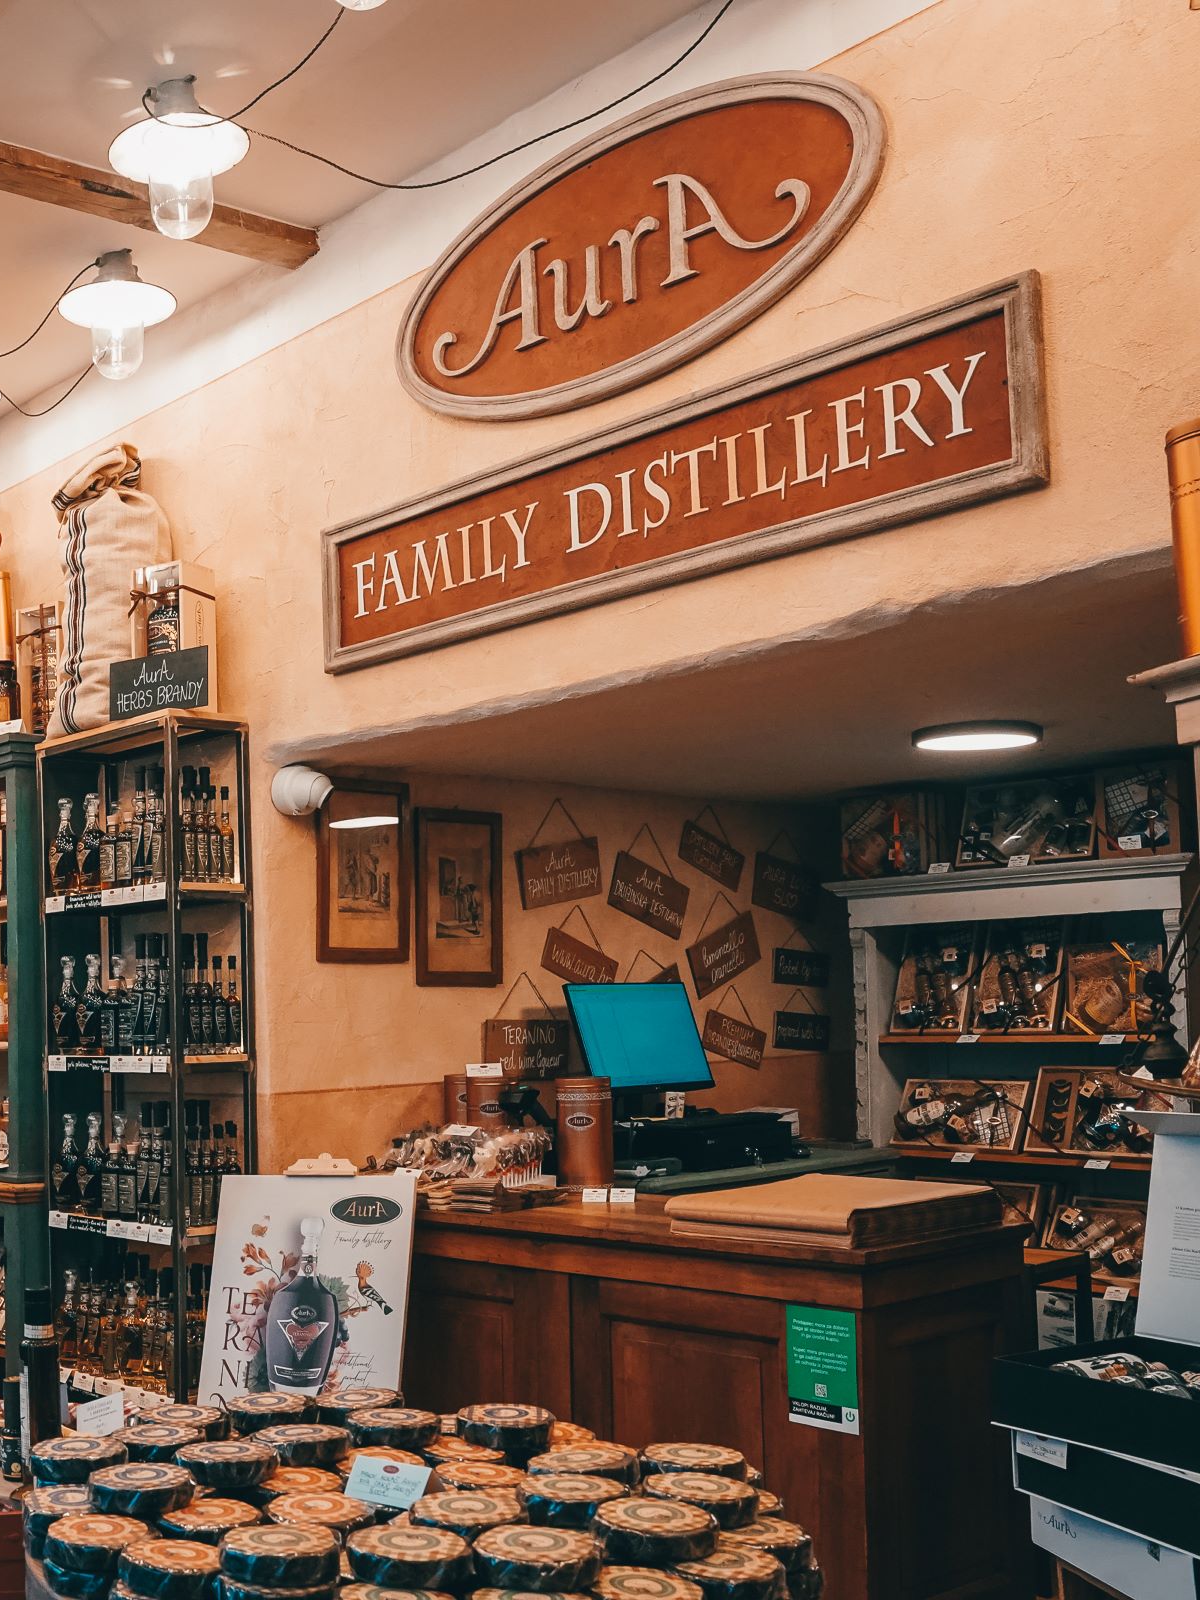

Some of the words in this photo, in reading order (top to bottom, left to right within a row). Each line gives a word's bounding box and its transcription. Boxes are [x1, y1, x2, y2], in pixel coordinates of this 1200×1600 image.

[432, 174, 812, 378] AurA
[352, 502, 540, 620] FAMILY
[563, 350, 987, 555] DISTILLERY
[133, 658, 175, 687] AurA
[116, 688, 154, 712] HERBS
[156, 677, 204, 706] BRANDY
[544, 850, 576, 872] AurA
[527, 874, 555, 898] FAMILY
[557, 868, 599, 893] DISTILLERY
[635, 872, 665, 897] AurA
[502, 1025, 556, 1045] TERANINO
[721, 1018, 755, 1041] PREMIUM
[342, 1200, 389, 1218] AurA
[1043, 1514, 1077, 1539] AurA
